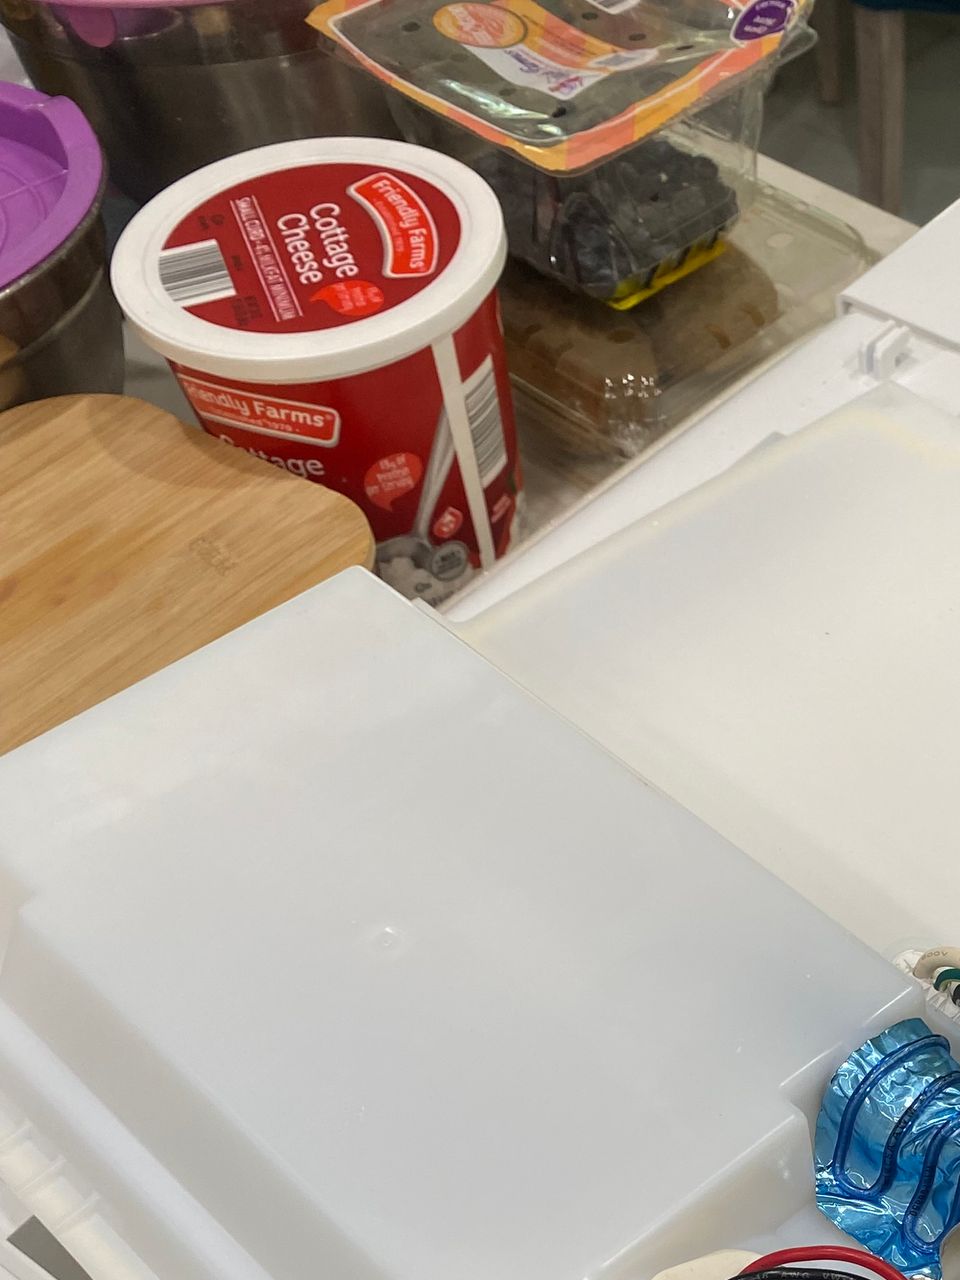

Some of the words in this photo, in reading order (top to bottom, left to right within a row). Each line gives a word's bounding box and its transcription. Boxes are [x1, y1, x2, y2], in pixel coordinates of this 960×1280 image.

[276, 212, 323, 285] Cheese
[309, 202, 359, 278] Cottage
[371, 179, 419, 229] Friendly
[408, 227, 427, 269] Farms
[253, 400, 325, 428] Farms
[219, 434, 325, 478] tage
